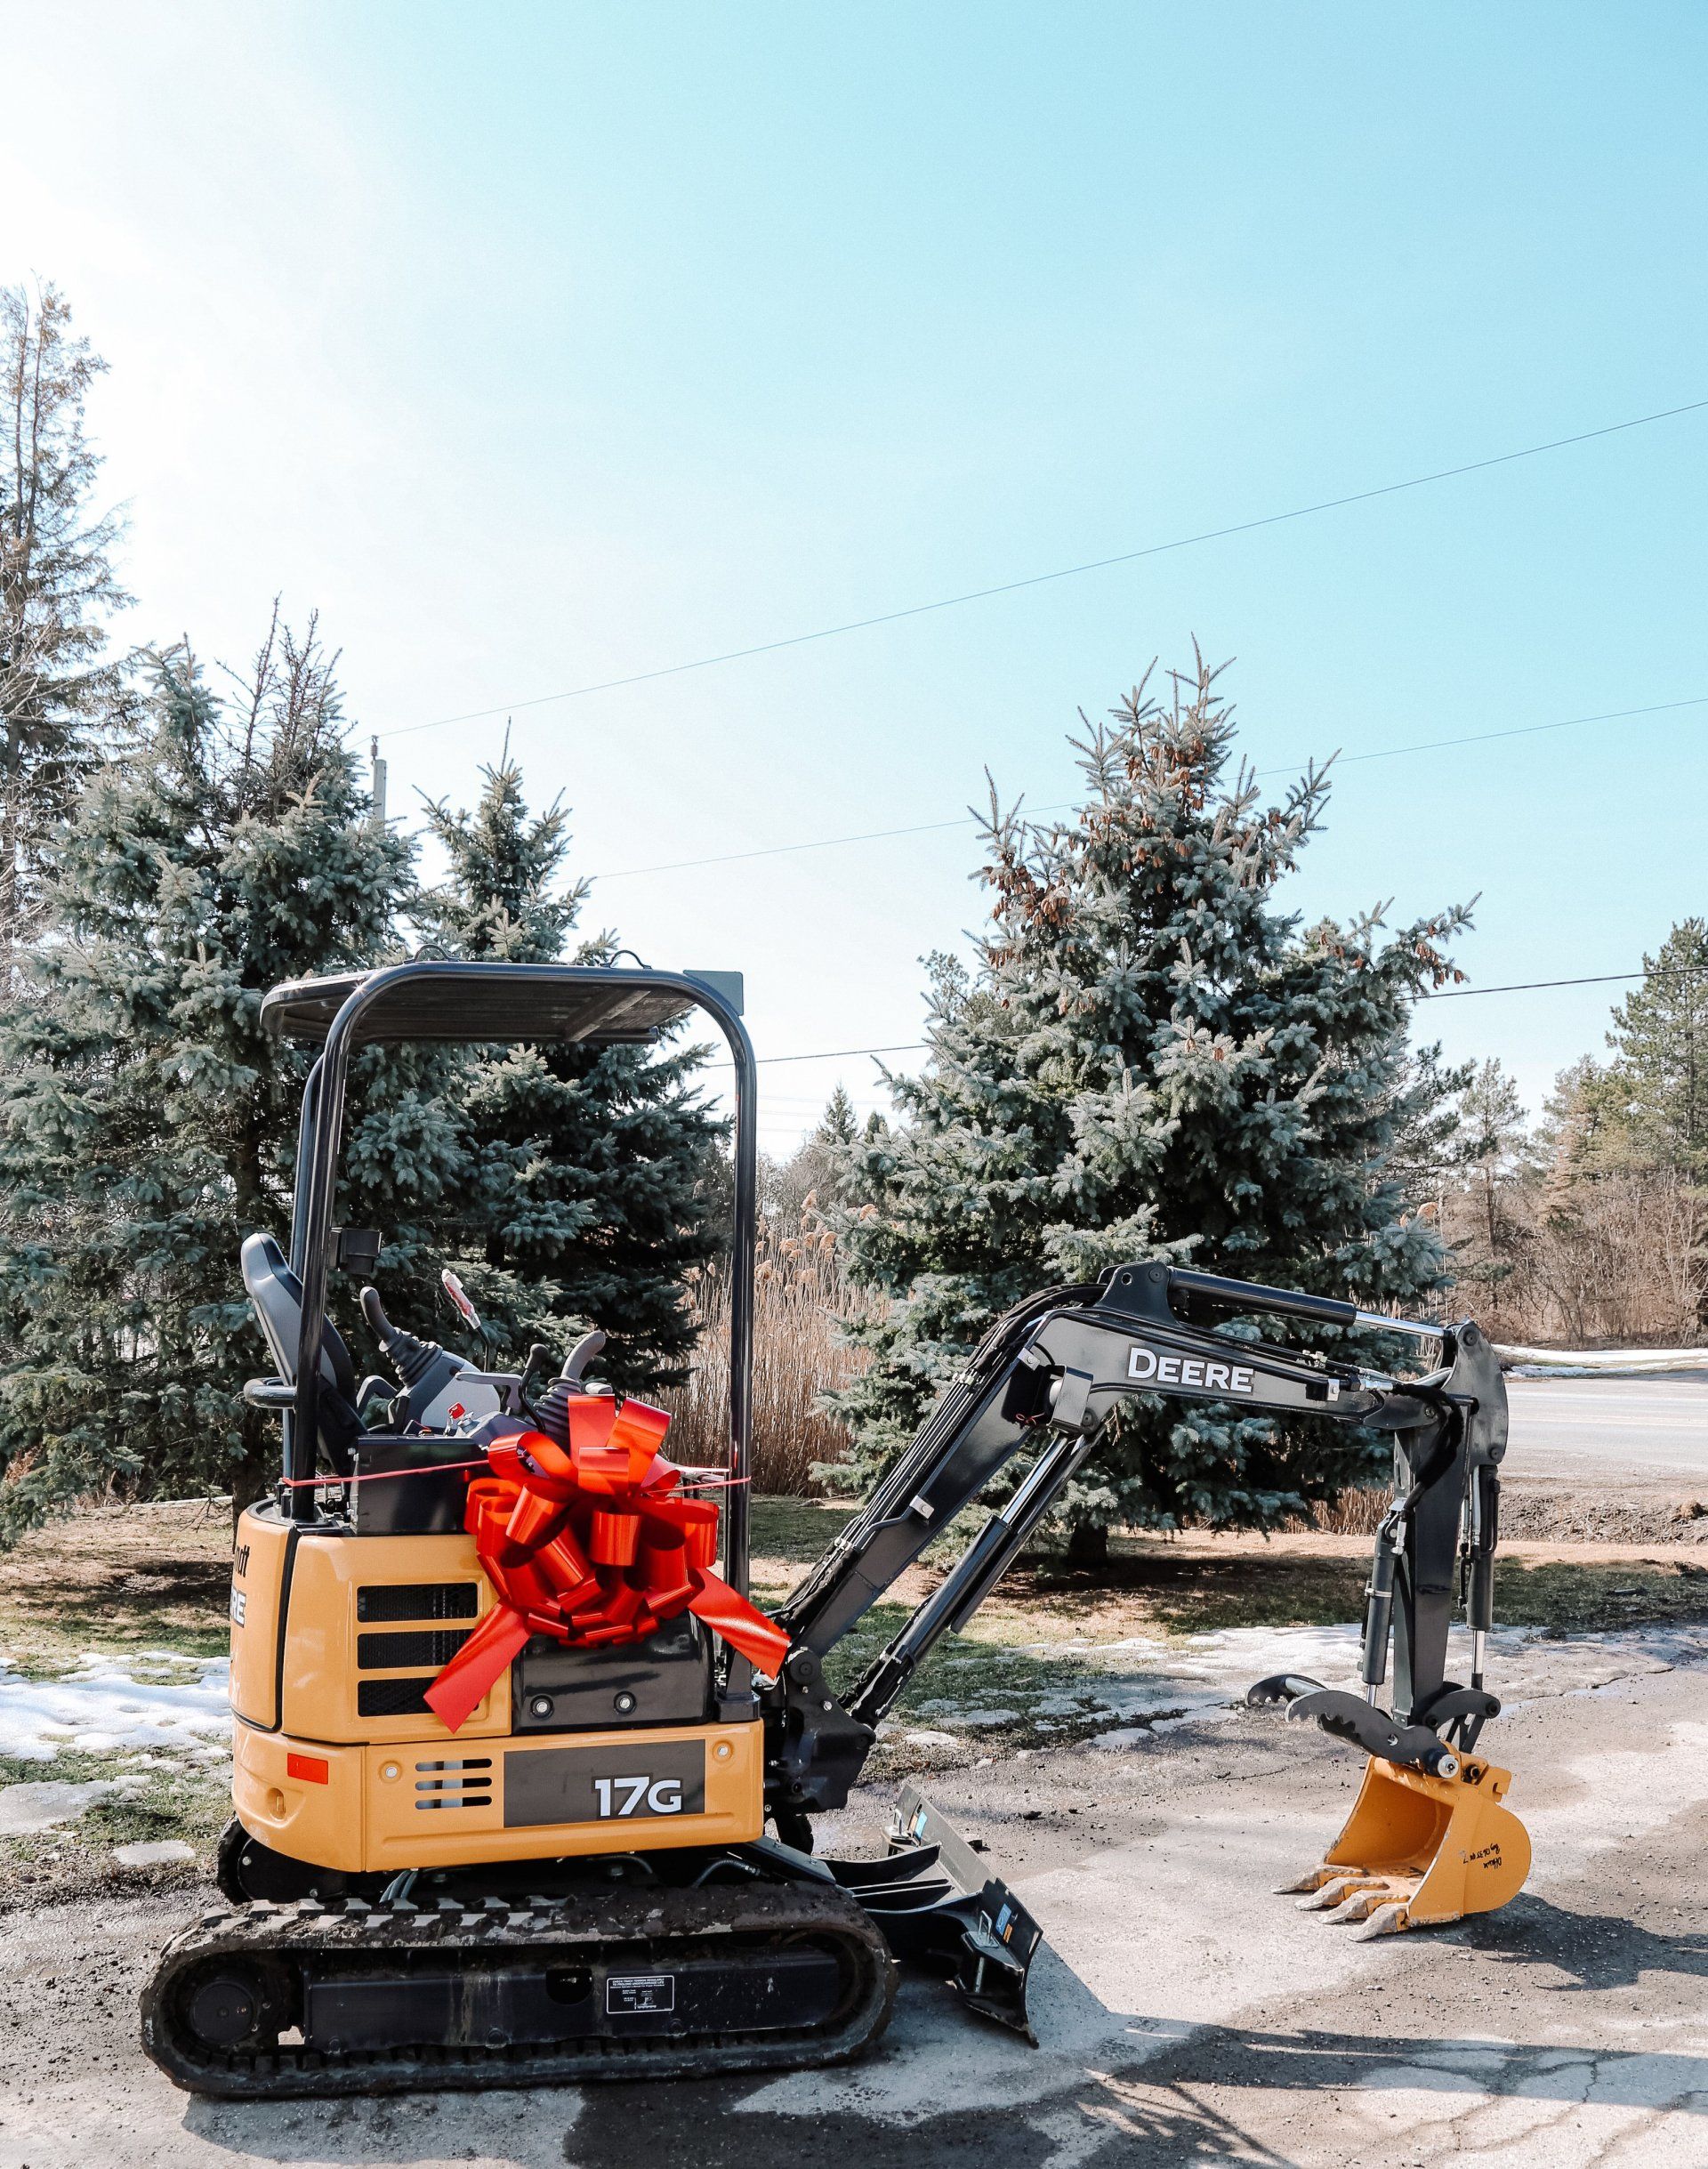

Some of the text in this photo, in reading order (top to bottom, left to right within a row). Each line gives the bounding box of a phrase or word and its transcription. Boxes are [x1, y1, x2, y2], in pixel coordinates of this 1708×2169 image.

[1127, 1346, 1254, 1393] DEERE
[230, 1586, 246, 1625] RE
[594, 1776, 682, 1817] 17G
